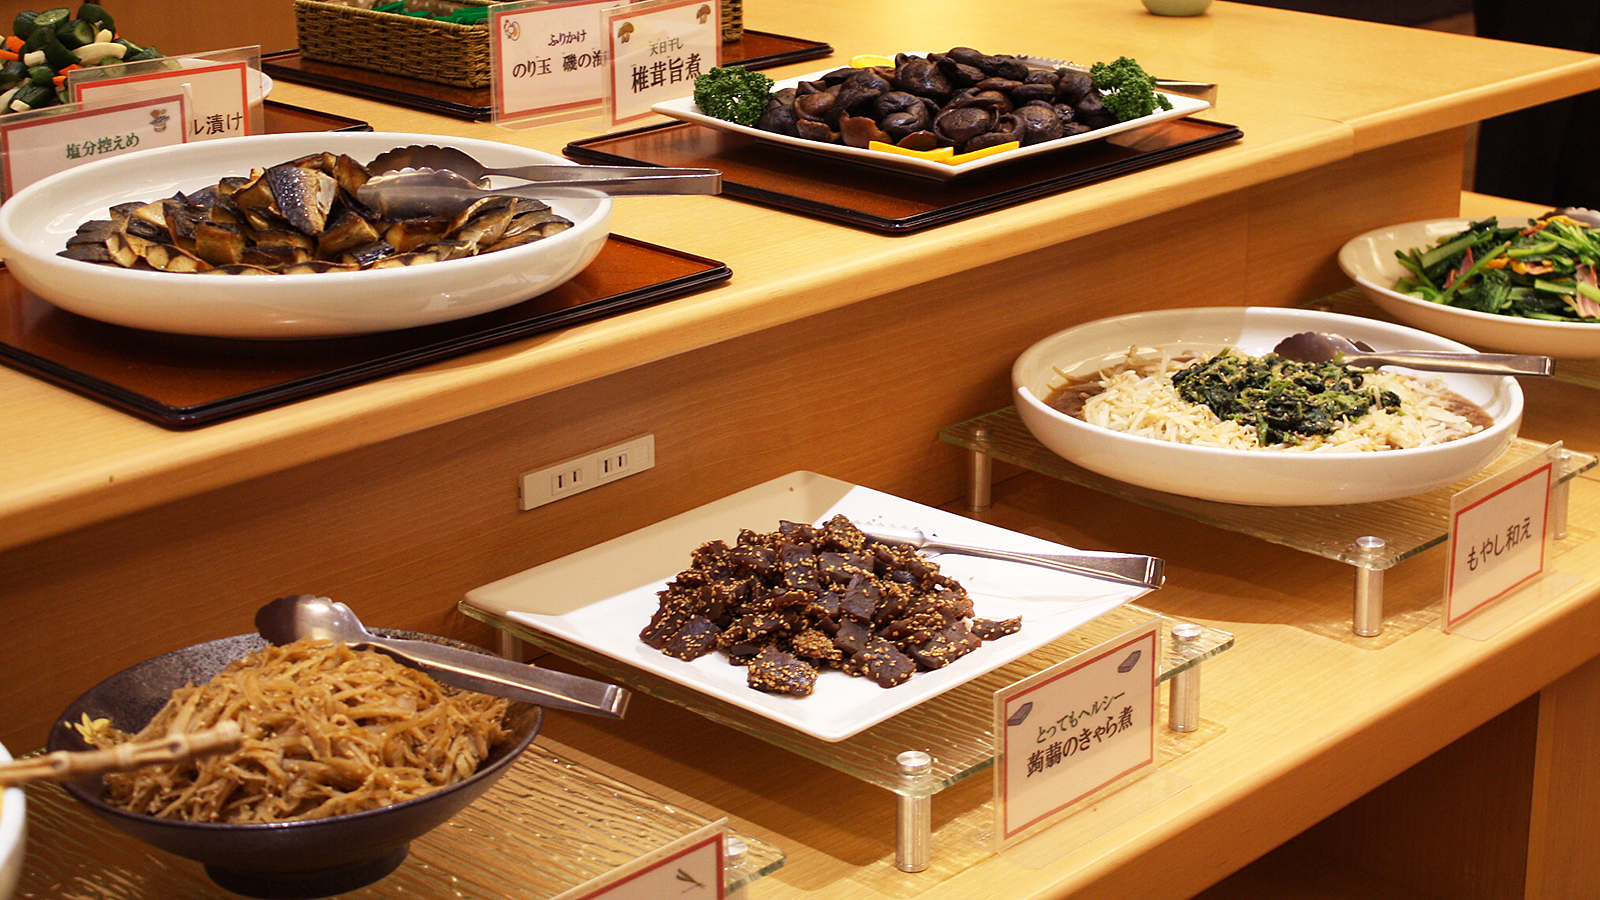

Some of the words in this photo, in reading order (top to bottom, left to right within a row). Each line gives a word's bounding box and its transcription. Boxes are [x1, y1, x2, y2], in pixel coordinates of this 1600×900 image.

[548, 29, 587, 46] ふりかけ
[649, 37, 684, 57] 天日干し
[512, 57, 552, 78] のり玉
[631, 53, 701, 93] 椎茸旨煮
[66, 132, 140, 159] 塩分控えめ
[1467, 516, 1532, 571] もやし和え
[1036, 691, 1125, 744] とってもヘルシー
[1027, 705, 1134, 778] 蒟蒻のきゃら煮
